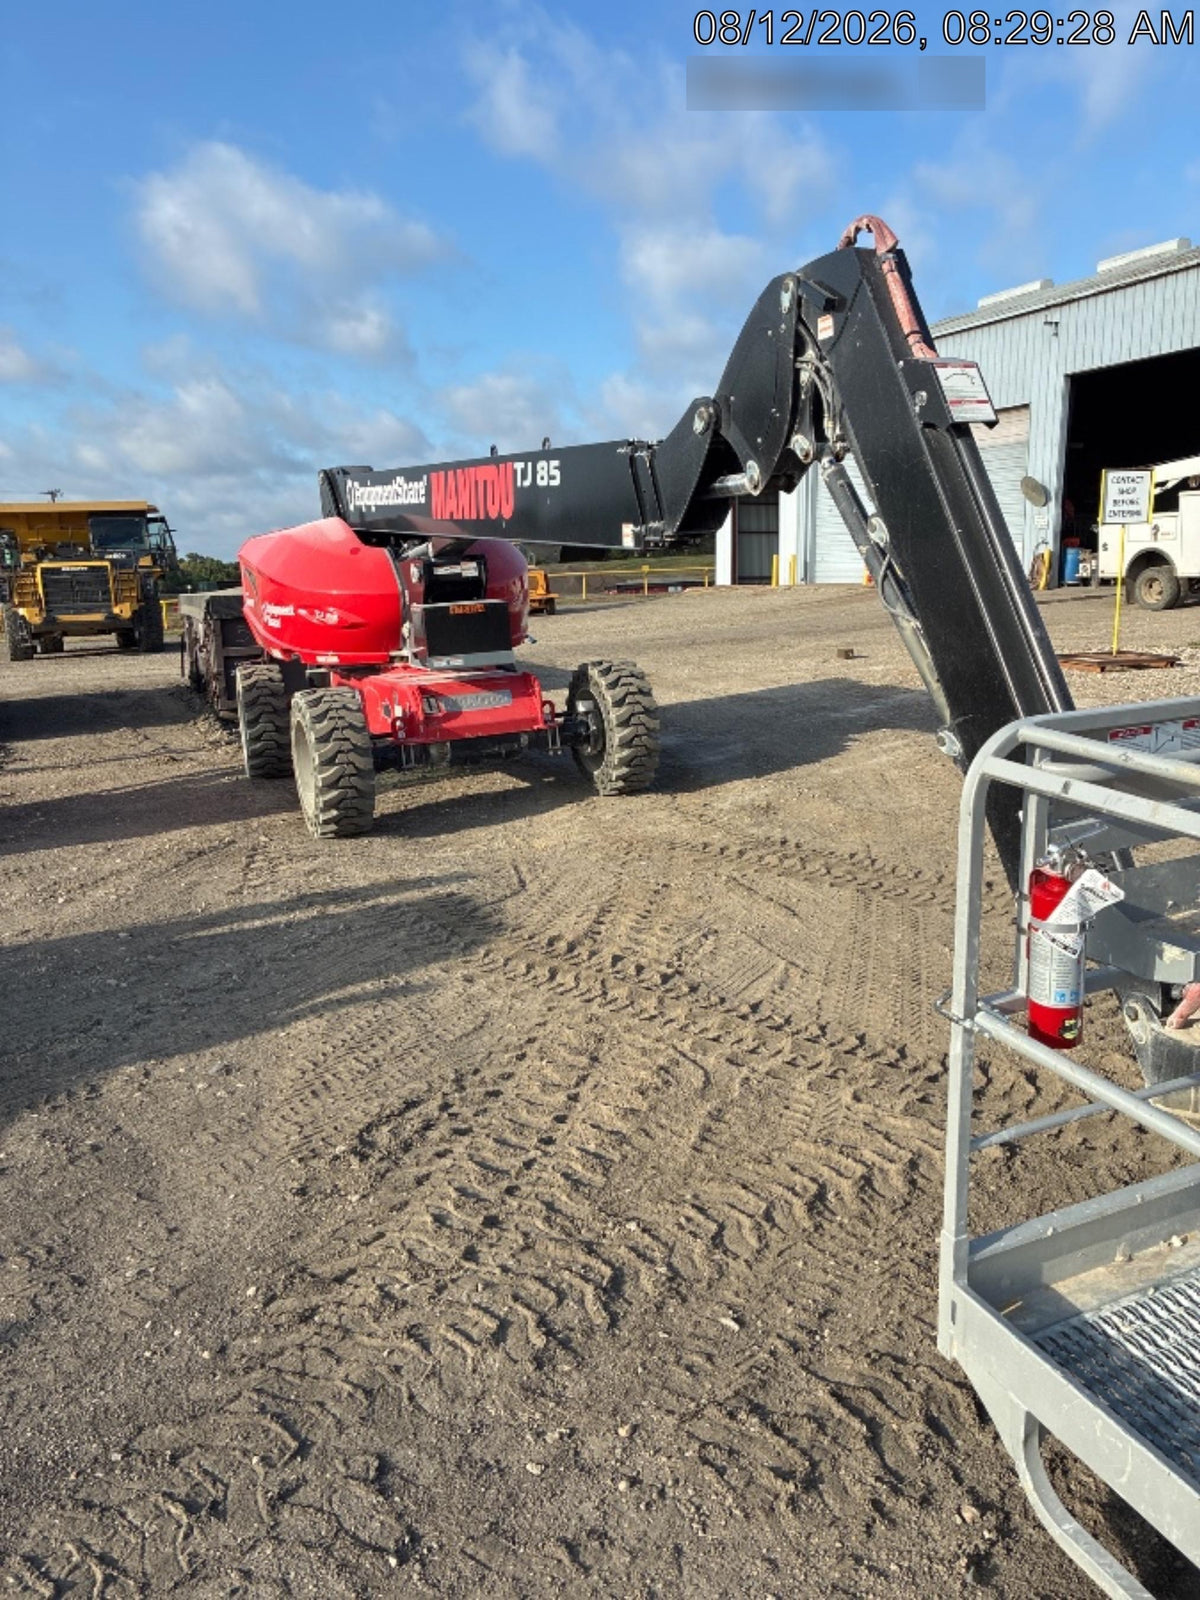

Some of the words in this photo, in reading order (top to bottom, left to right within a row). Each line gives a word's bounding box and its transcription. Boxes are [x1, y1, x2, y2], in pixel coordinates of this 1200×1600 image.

[1111, 475, 1144, 484] CONTACT
[430, 462, 514, 520] MANITOU
[514, 461, 533, 488] TJ
[536, 460, 561, 487] 85
[1112, 498, 1140, 507] BEFORE
